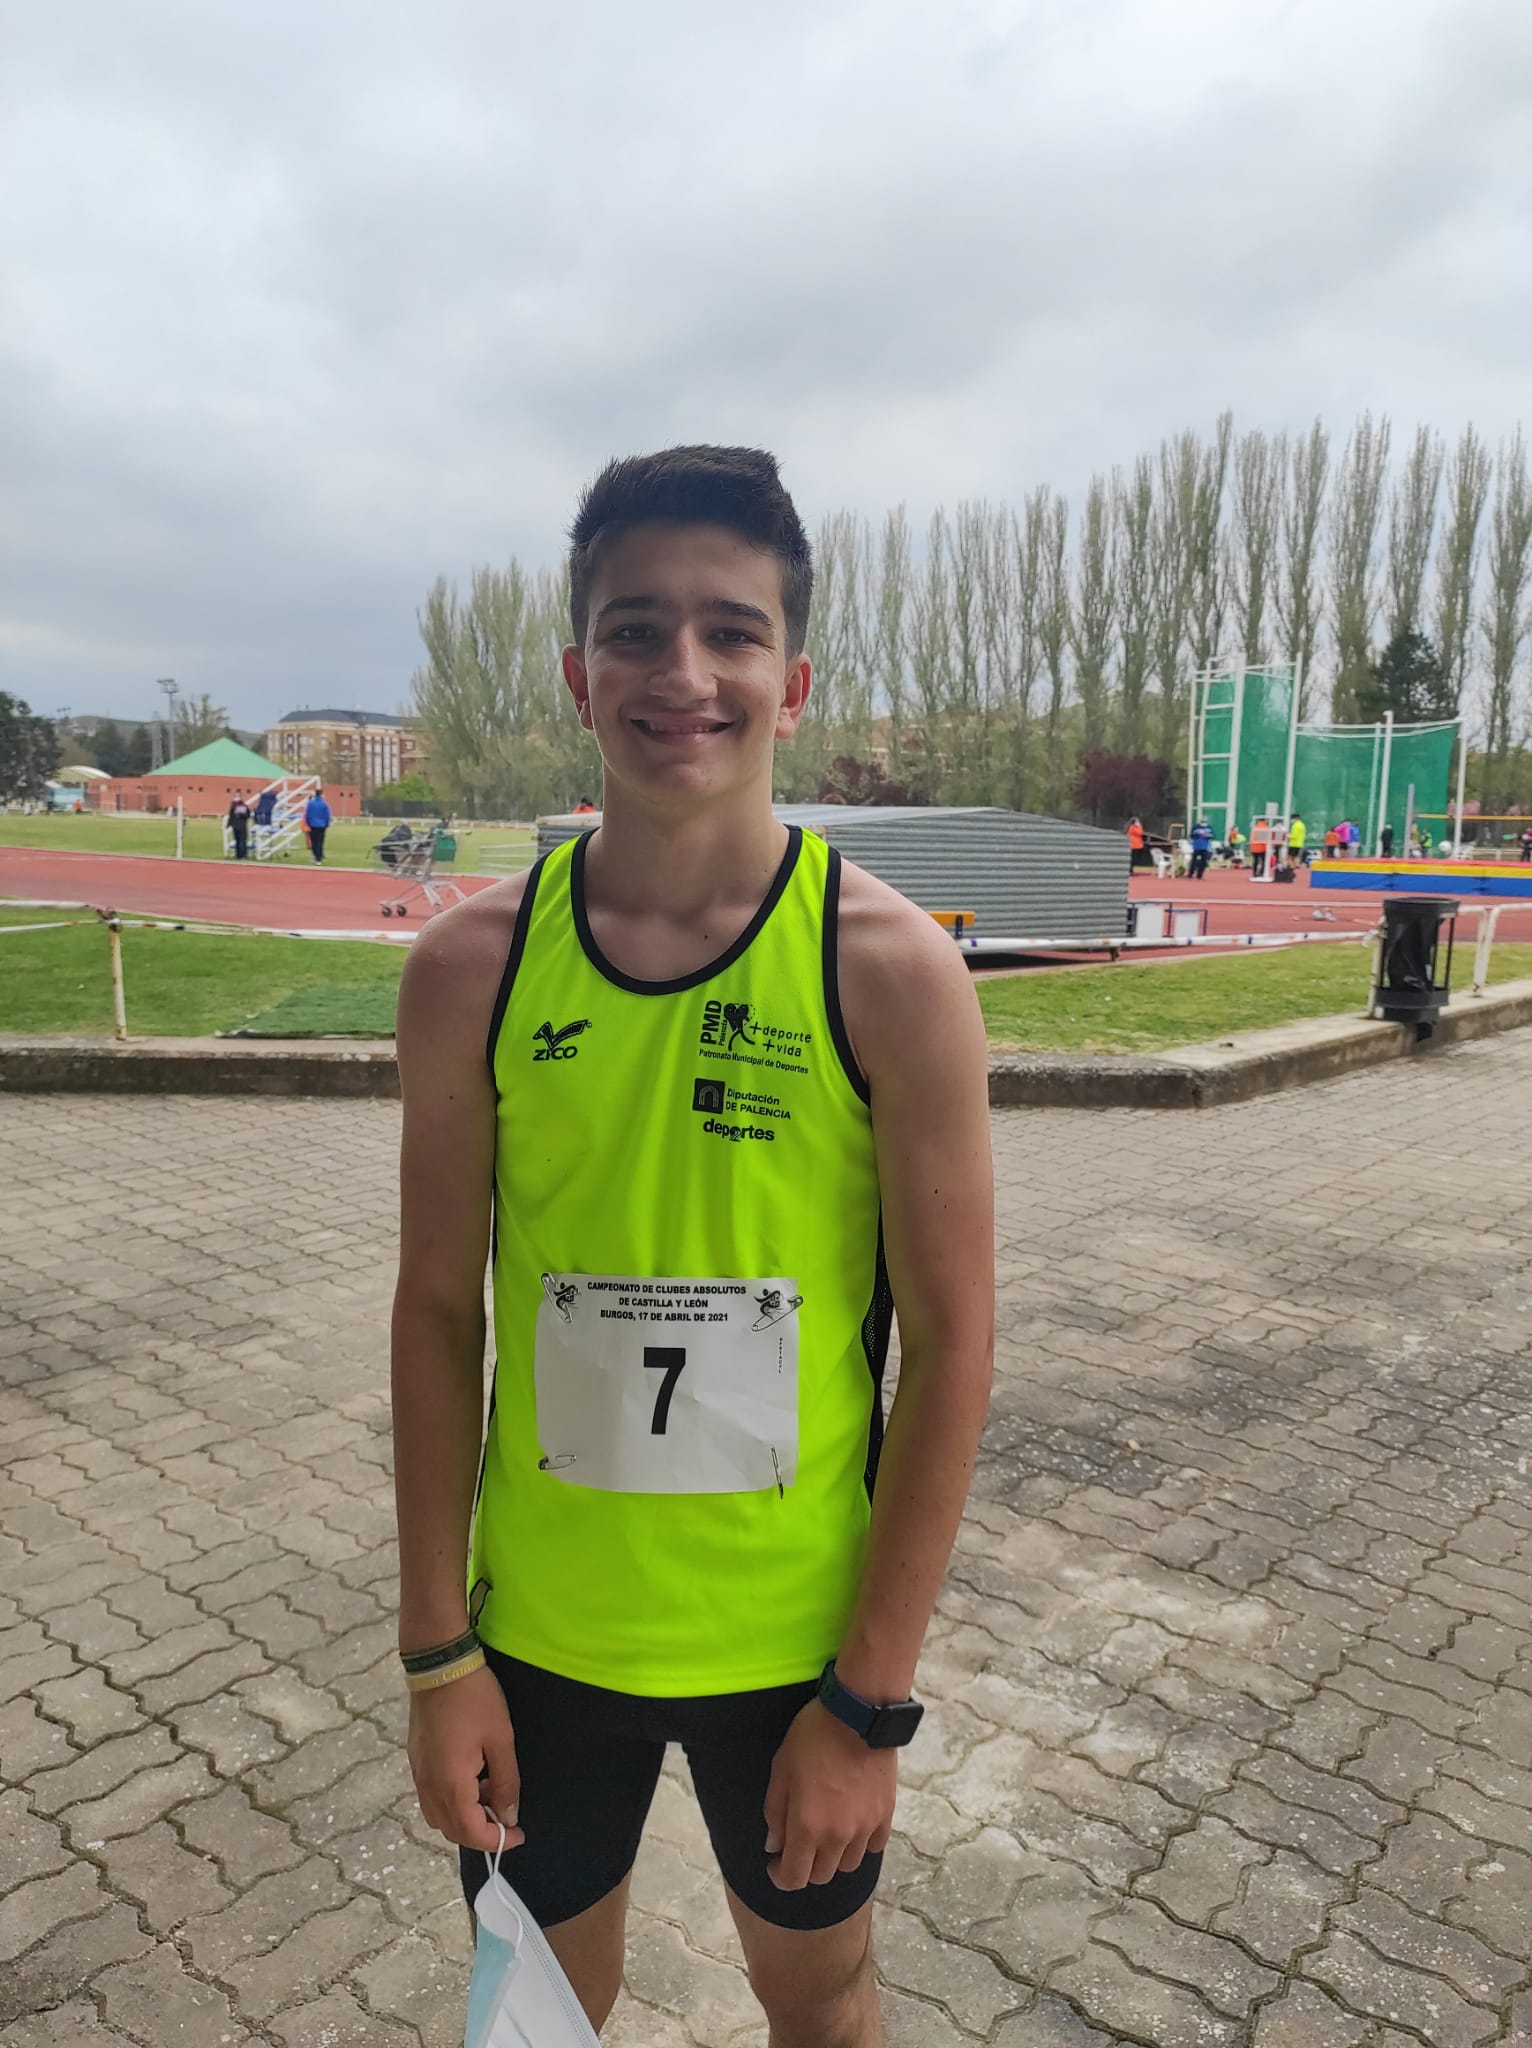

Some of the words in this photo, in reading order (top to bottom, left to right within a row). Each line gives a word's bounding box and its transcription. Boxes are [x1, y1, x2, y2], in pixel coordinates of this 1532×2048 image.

[700, 1000, 722, 1045] PMD
[718, 1019, 728, 1046] Palencia
[533, 1046, 577, 1061] ZICO
[699, 1048, 732, 1060] Patronato
[732, 1052, 764, 1066] Municipal
[765, 1058, 774, 1067] de
[776, 1060, 809, 1074] Deportes
[727, 1088, 780, 1106] Diputación
[725, 1101, 738, 1111] DE
[740, 1103, 792, 1120] PALENCIA
[703, 1118, 775, 1142] deportes
[587, 1282, 640, 1294] CAMPEONATO
[642, 1285, 654, 1294] DE
[655, 1286, 691, 1294] CLUBES
[693, 1286, 747, 1295] ABSOLUTOS
[619, 1297, 630, 1306] DE
[631, 1298, 673, 1307] CASTILLA
[675, 1299, 682, 1307] Y
[684, 1297, 709, 1308] LEÓN
[600, 1309, 636, 1321] BURGOS,
[638, 1312, 648, 1321] 17
[650, 1313, 663, 1321] DE
[664, 1313, 692, 1322] ABRIL
[694, 1313, 706, 1322] DE
[708, 1313, 729, 1322] 2021
[643, 1347, 686, 1435] 7
